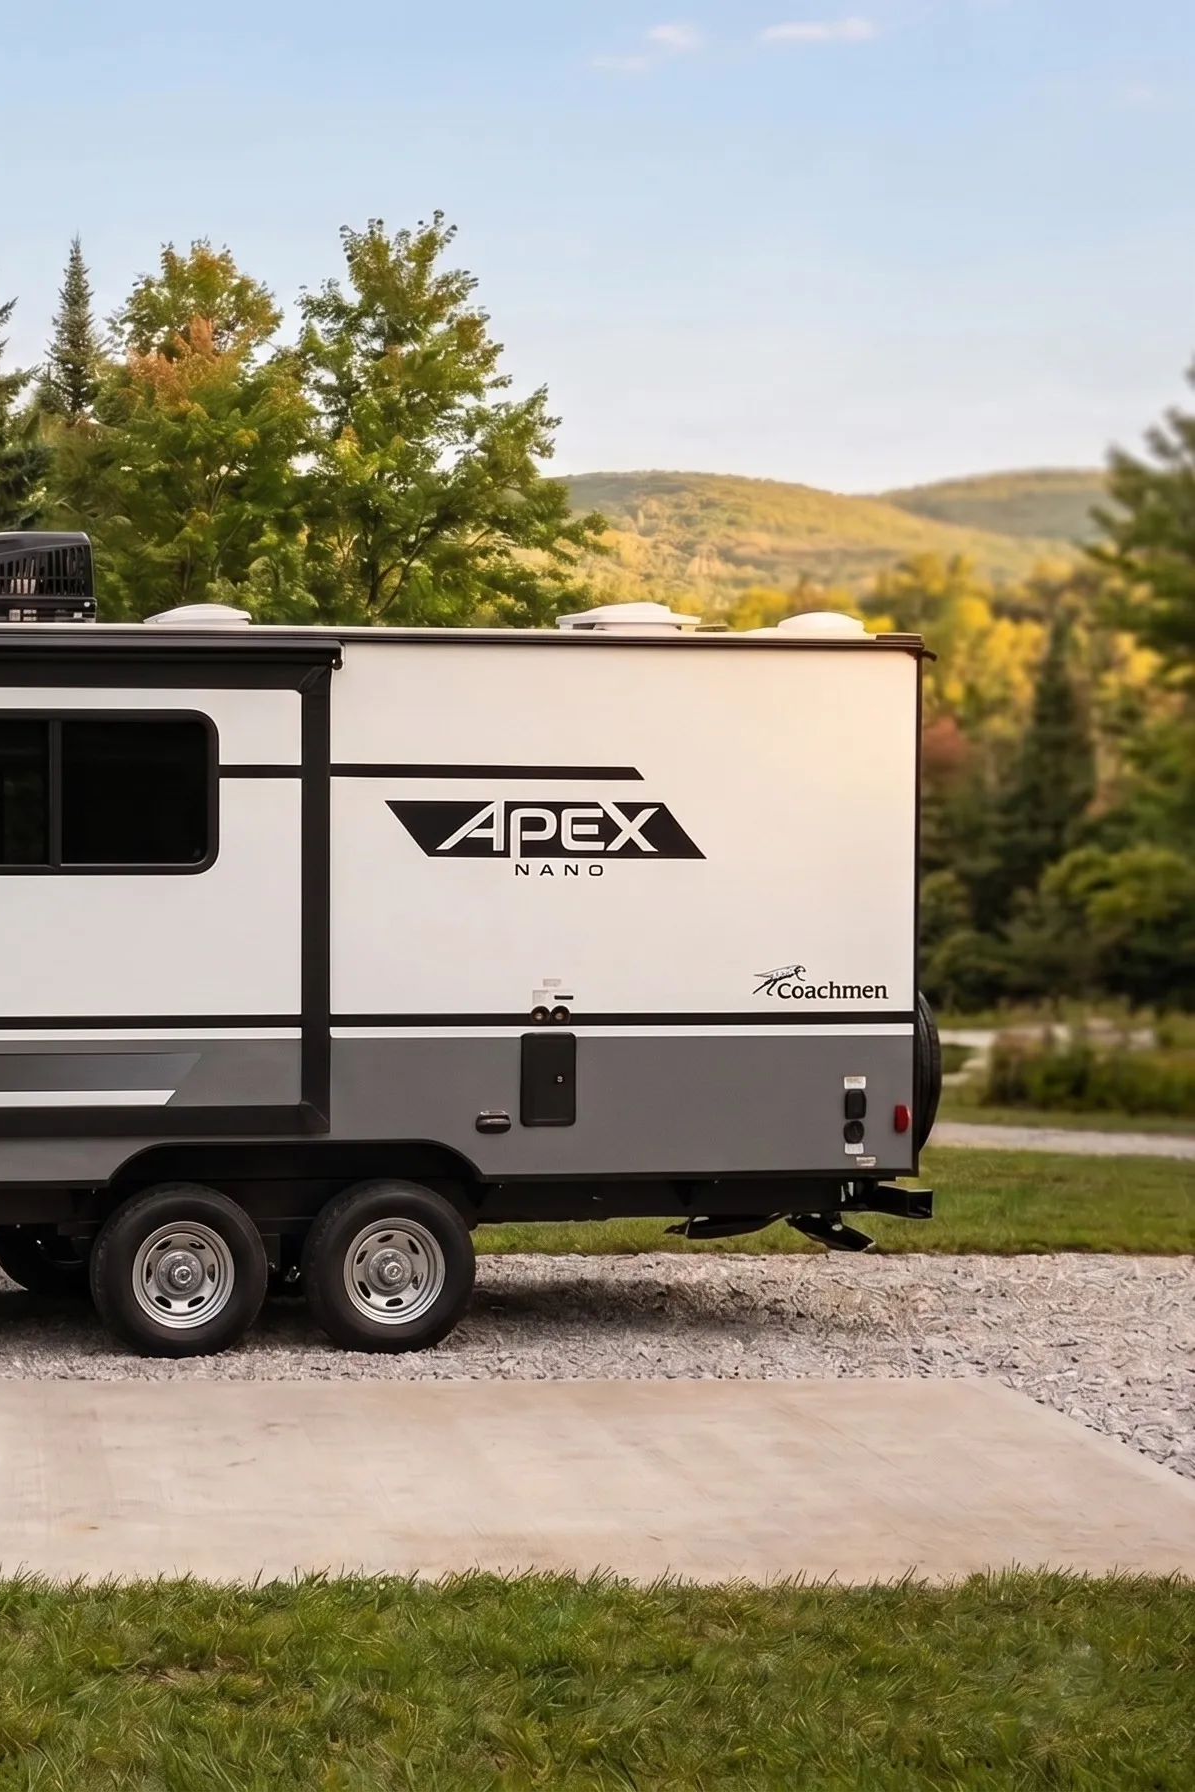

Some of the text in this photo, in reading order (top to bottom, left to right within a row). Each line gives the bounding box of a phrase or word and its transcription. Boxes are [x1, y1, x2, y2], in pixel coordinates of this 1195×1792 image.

[435, 801, 660, 858] APEX
[514, 863, 604, 877] NANO
[777, 981, 889, 1000] Coachmen
